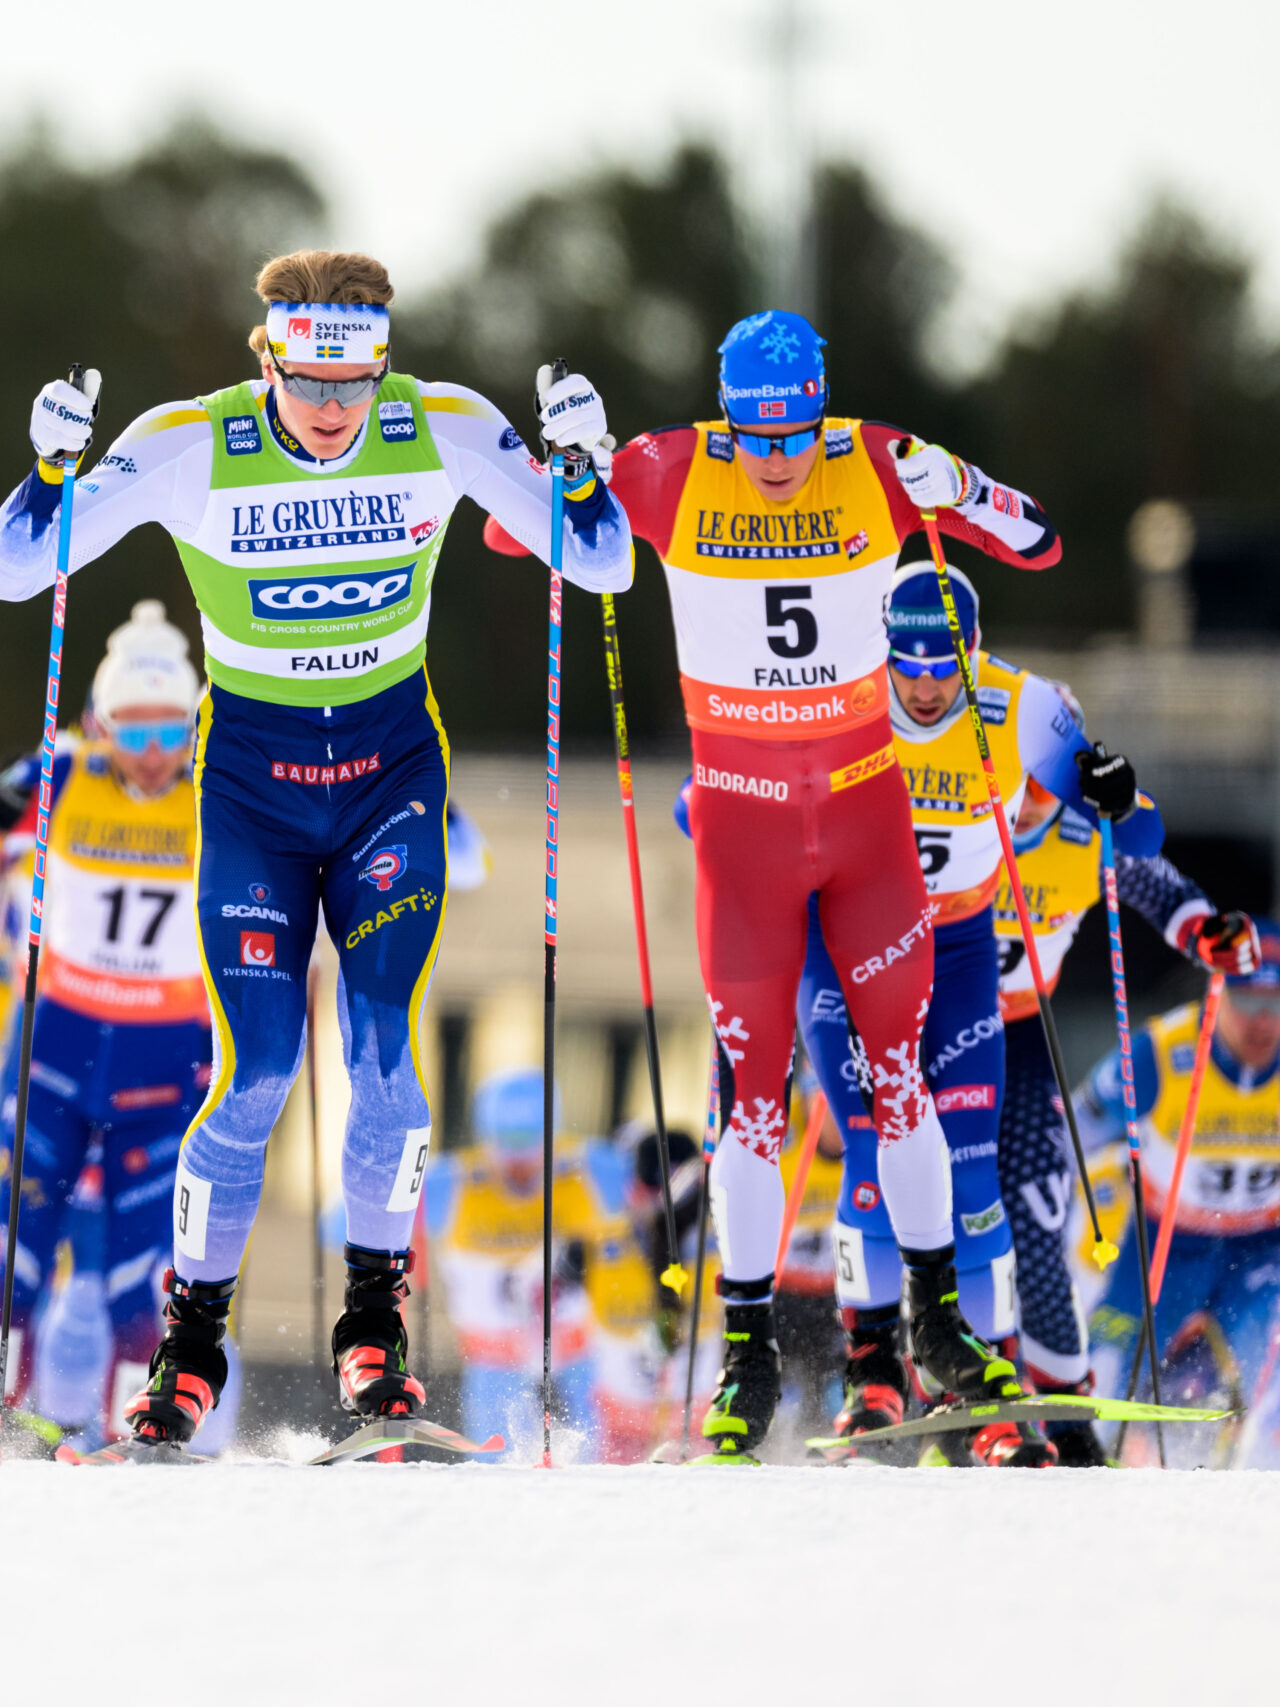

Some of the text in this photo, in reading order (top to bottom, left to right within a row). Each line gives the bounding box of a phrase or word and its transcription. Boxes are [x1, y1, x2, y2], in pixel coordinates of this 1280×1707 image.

[315, 322, 372, 332] SVENSKA
[315, 332, 350, 341] SPEL
[726, 383, 803, 400] SpareBank
[230, 439, 256, 450] coop
[273, 418, 299, 452] LYKO
[383, 422, 414, 435] coop
[231, 505, 266, 537] LE
[696, 509, 725, 540] LE
[239, 530, 399, 552] SWITZERLAND
[701, 542, 836, 558] SWITZERLAND
[257, 573, 409, 610] coop
[936, 577, 960, 631] LEKI
[250, 600, 415, 634] FIS CROSS COUNTRY WORLD CUP
[601, 592, 616, 626] EKI
[765, 585, 819, 659] 5
[291, 646, 379, 672] FALUN
[754, 664, 837, 687] FALUN
[707, 693, 846, 723] Swedbank
[274, 754, 381, 783] BAUHAUS
[545, 643, 562, 880] TORNADO
[842, 751, 891, 783] DHL
[696, 763, 789, 802] ELDORADO
[902, 763, 969, 799] YÈRE
[351, 808, 412, 864] Sundström
[914, 830, 952, 876] 5
[358, 860, 393, 880] Thermia
[99, 884, 179, 948] 17
[221, 904, 289, 927] SCANIA
[345, 894, 420, 950] CRAFT
[850, 919, 930, 985] CRAFT
[222, 966, 292, 982] SVENSKA SPEL
[937, 1087, 989, 1111] enel
[409, 1143, 429, 1194] 9
[178, 1184, 191, 1236] 9
